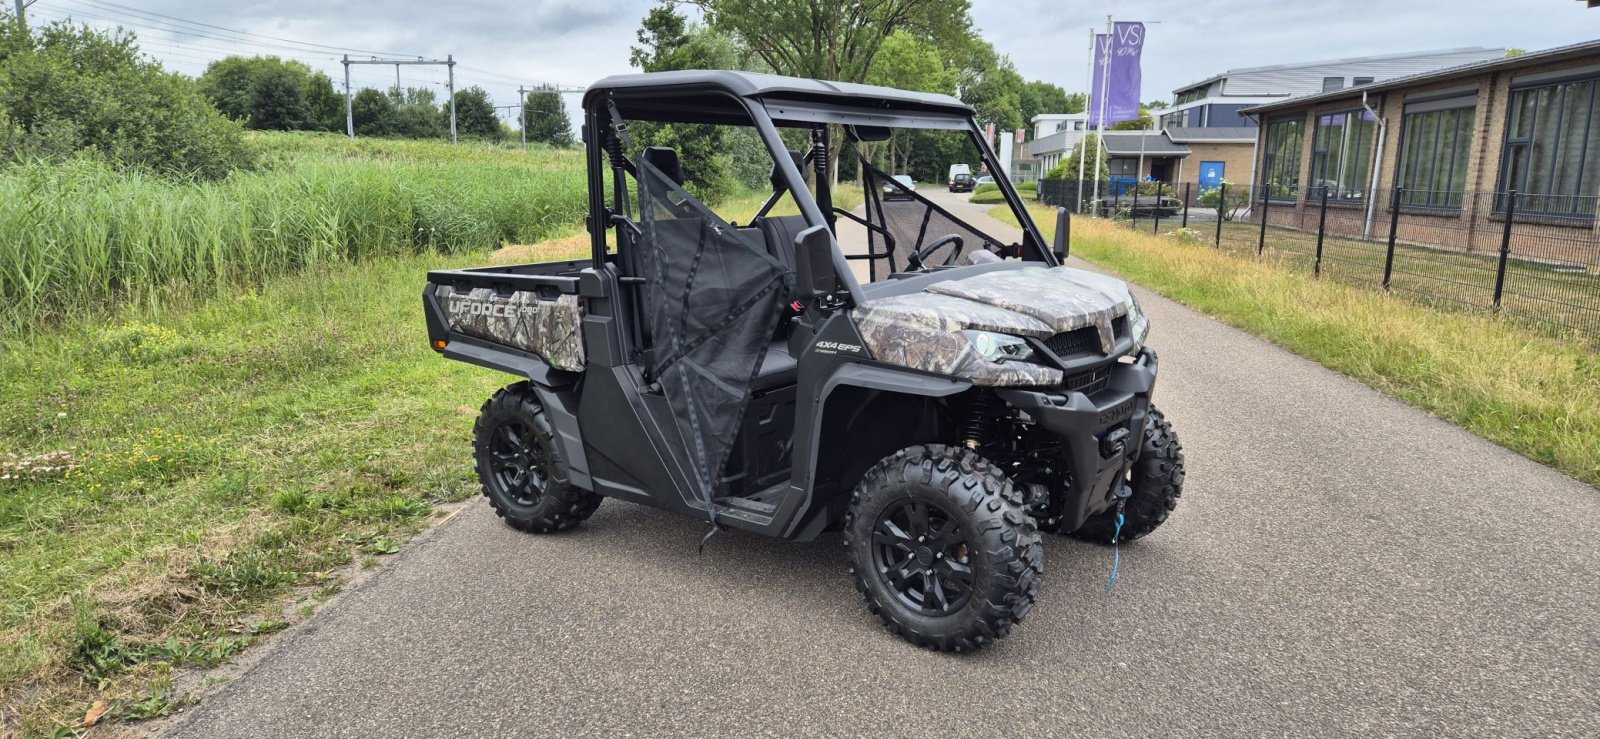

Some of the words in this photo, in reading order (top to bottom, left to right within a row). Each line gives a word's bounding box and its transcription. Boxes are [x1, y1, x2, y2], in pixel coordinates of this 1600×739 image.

[449, 300, 517, 318] UFORCE
[816, 341, 838, 349] 4X4
[837, 343, 862, 353] EPS
